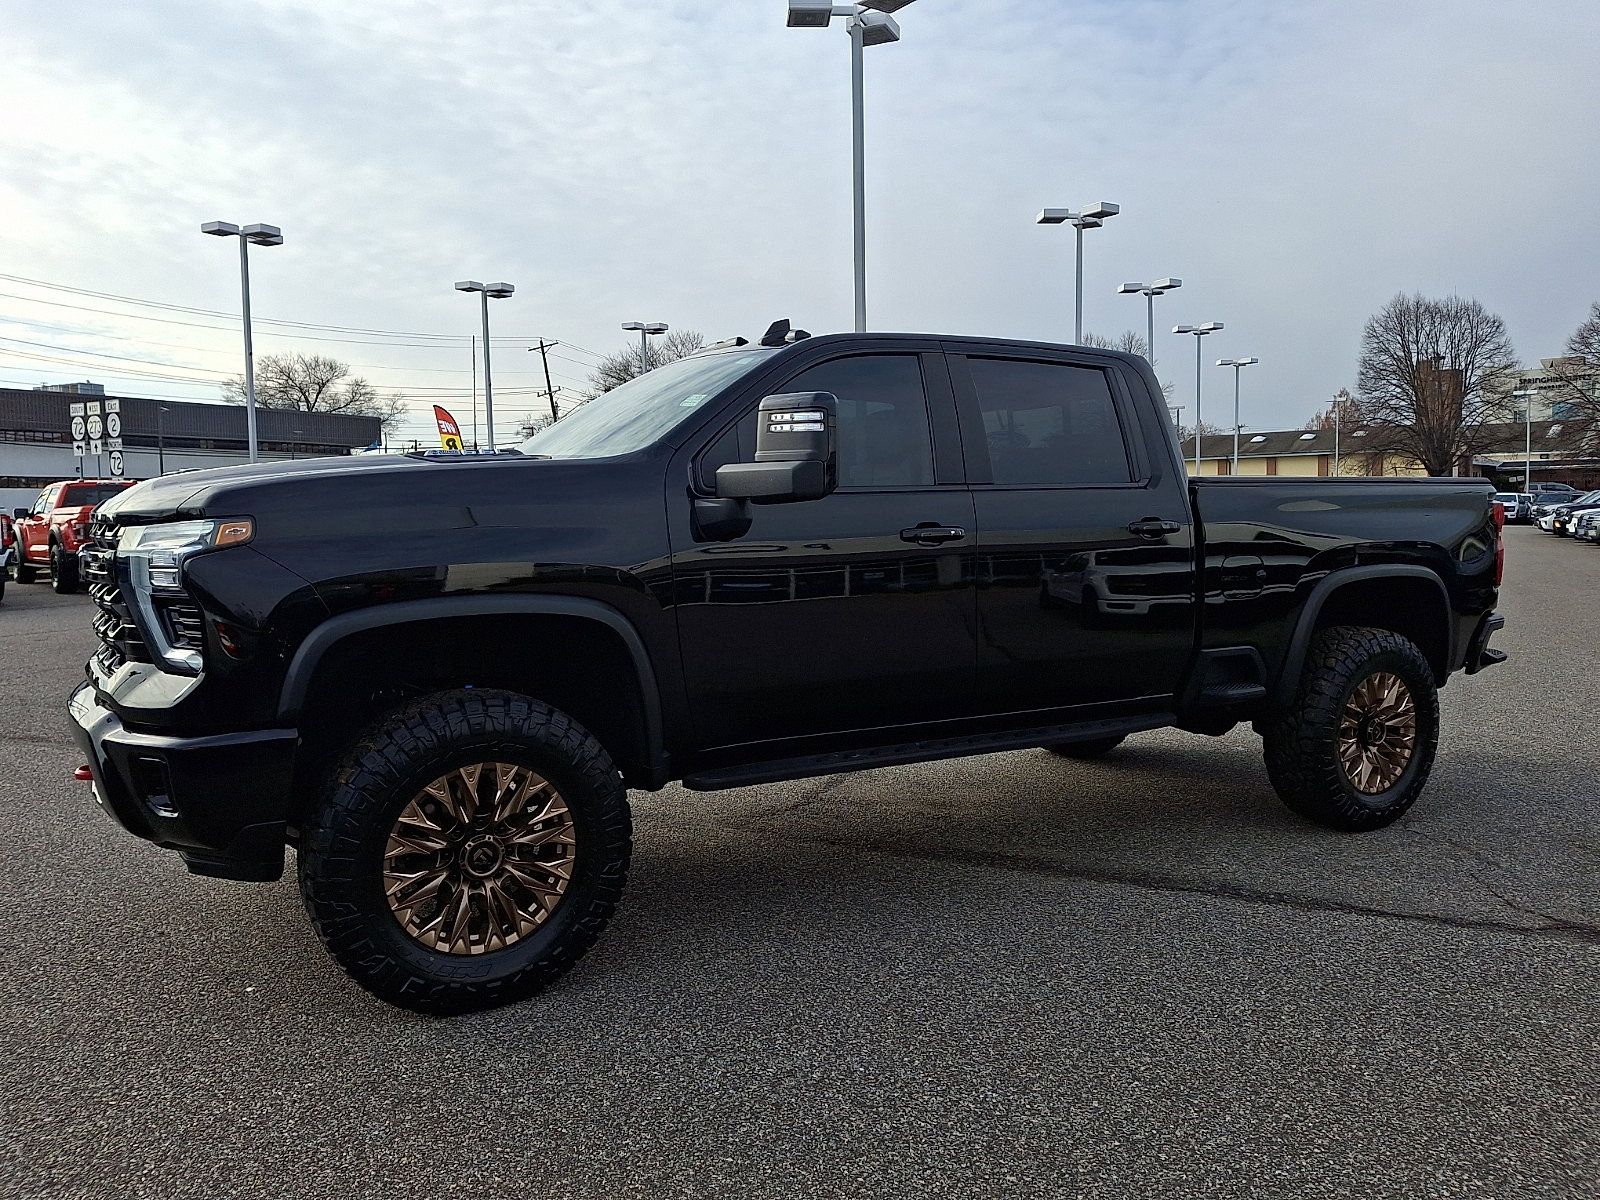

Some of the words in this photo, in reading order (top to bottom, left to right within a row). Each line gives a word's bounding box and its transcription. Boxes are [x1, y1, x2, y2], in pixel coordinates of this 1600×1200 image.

[71, 406, 83, 414] SOUTH
[88, 404, 98, 412] WEST
[107, 402, 117, 411] EAST
[73, 422, 83, 435] 72
[89, 421, 101, 434] 273
[111, 418, 117, 432] 2
[111, 456, 122, 470] 72
